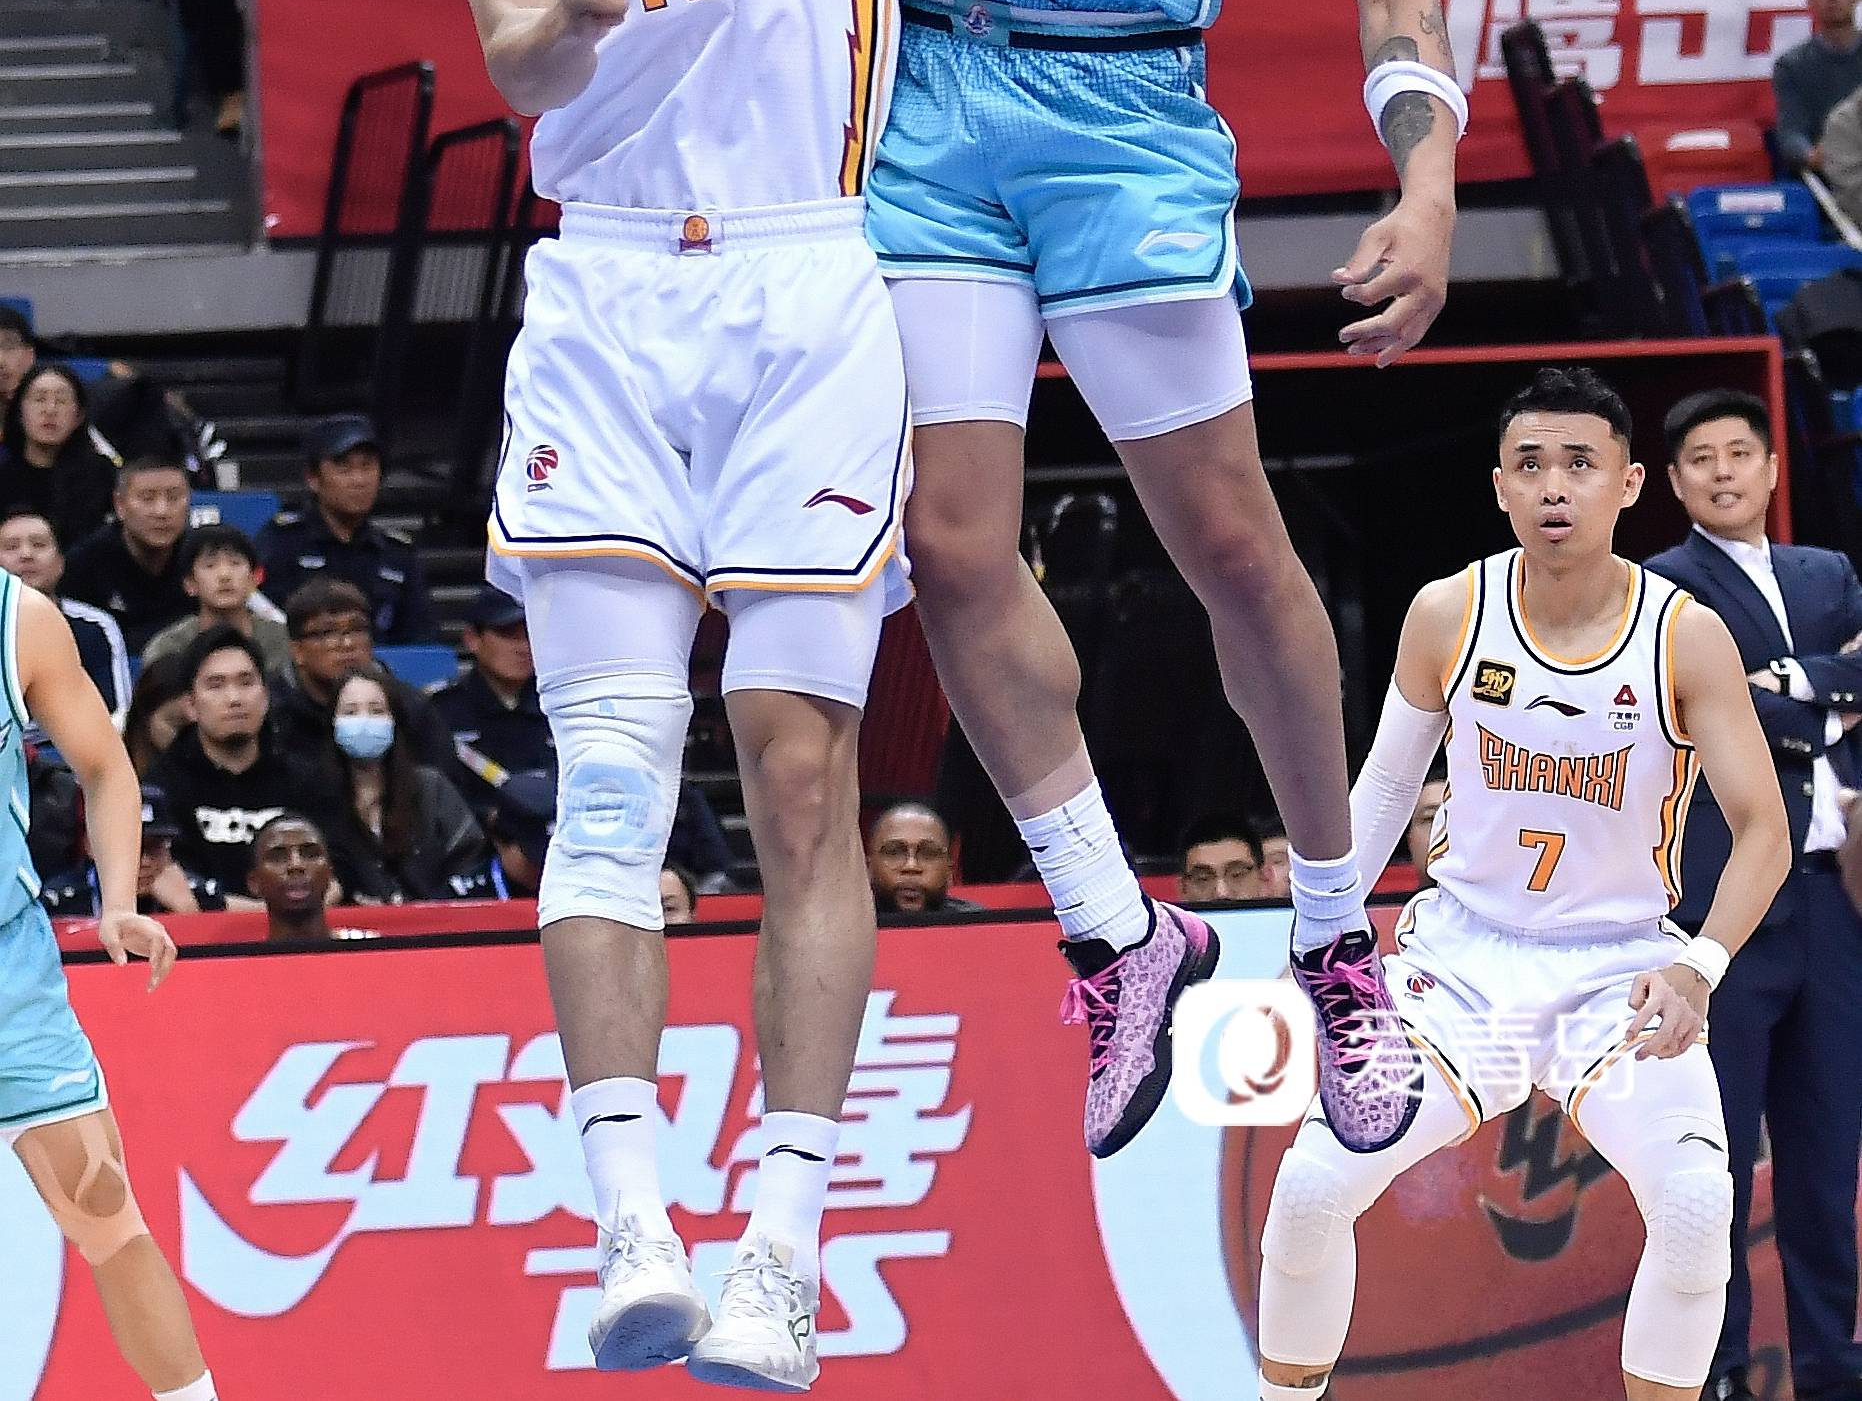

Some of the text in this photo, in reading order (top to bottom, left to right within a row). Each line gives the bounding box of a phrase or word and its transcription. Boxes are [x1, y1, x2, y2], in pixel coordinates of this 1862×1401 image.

[1613, 721, 1634, 730] CGB
[1475, 721, 1636, 811] SHANXI
[1518, 828, 1566, 892] 7
